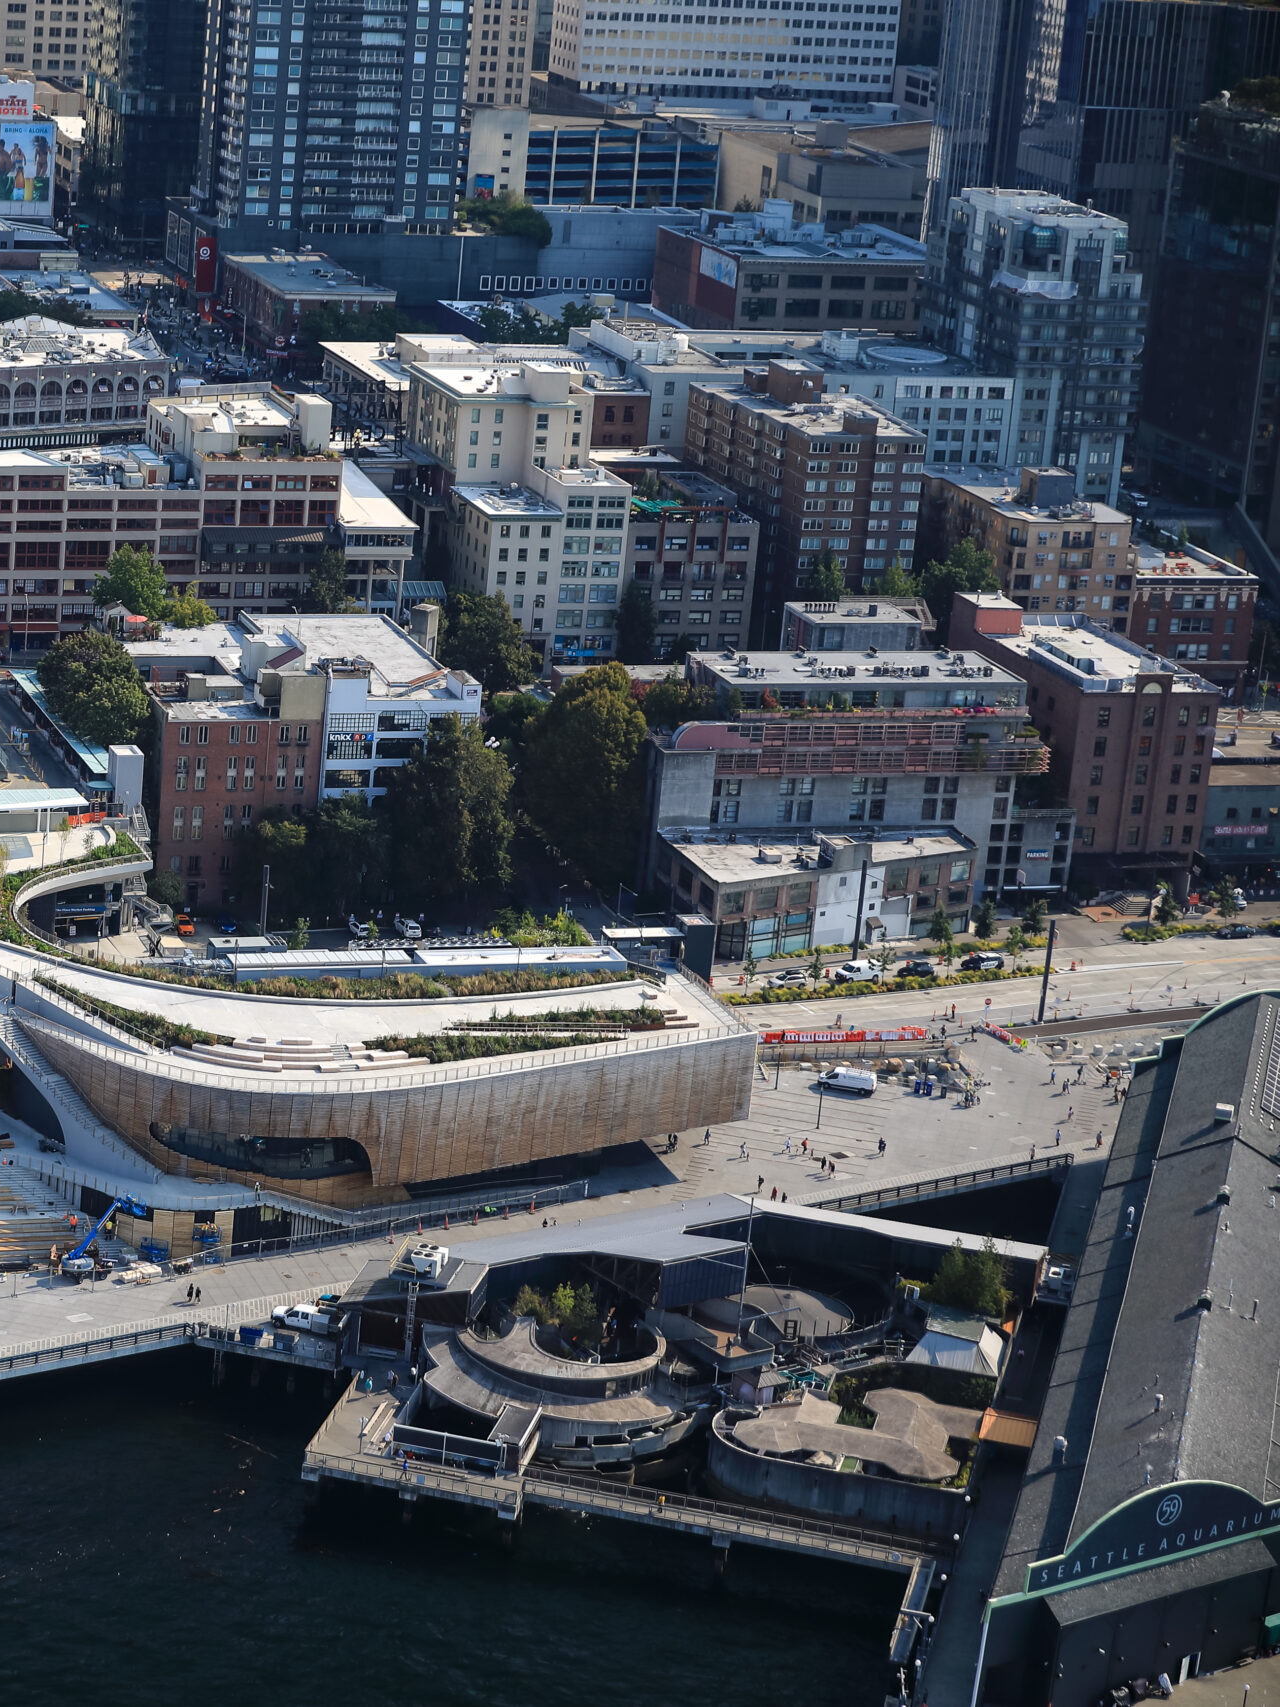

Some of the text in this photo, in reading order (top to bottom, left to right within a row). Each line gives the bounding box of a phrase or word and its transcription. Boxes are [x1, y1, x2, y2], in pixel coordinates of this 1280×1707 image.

[1161, 1496, 1179, 1523] 59
[1040, 1508, 1280, 1583] SEATTLE AQUARIUM
